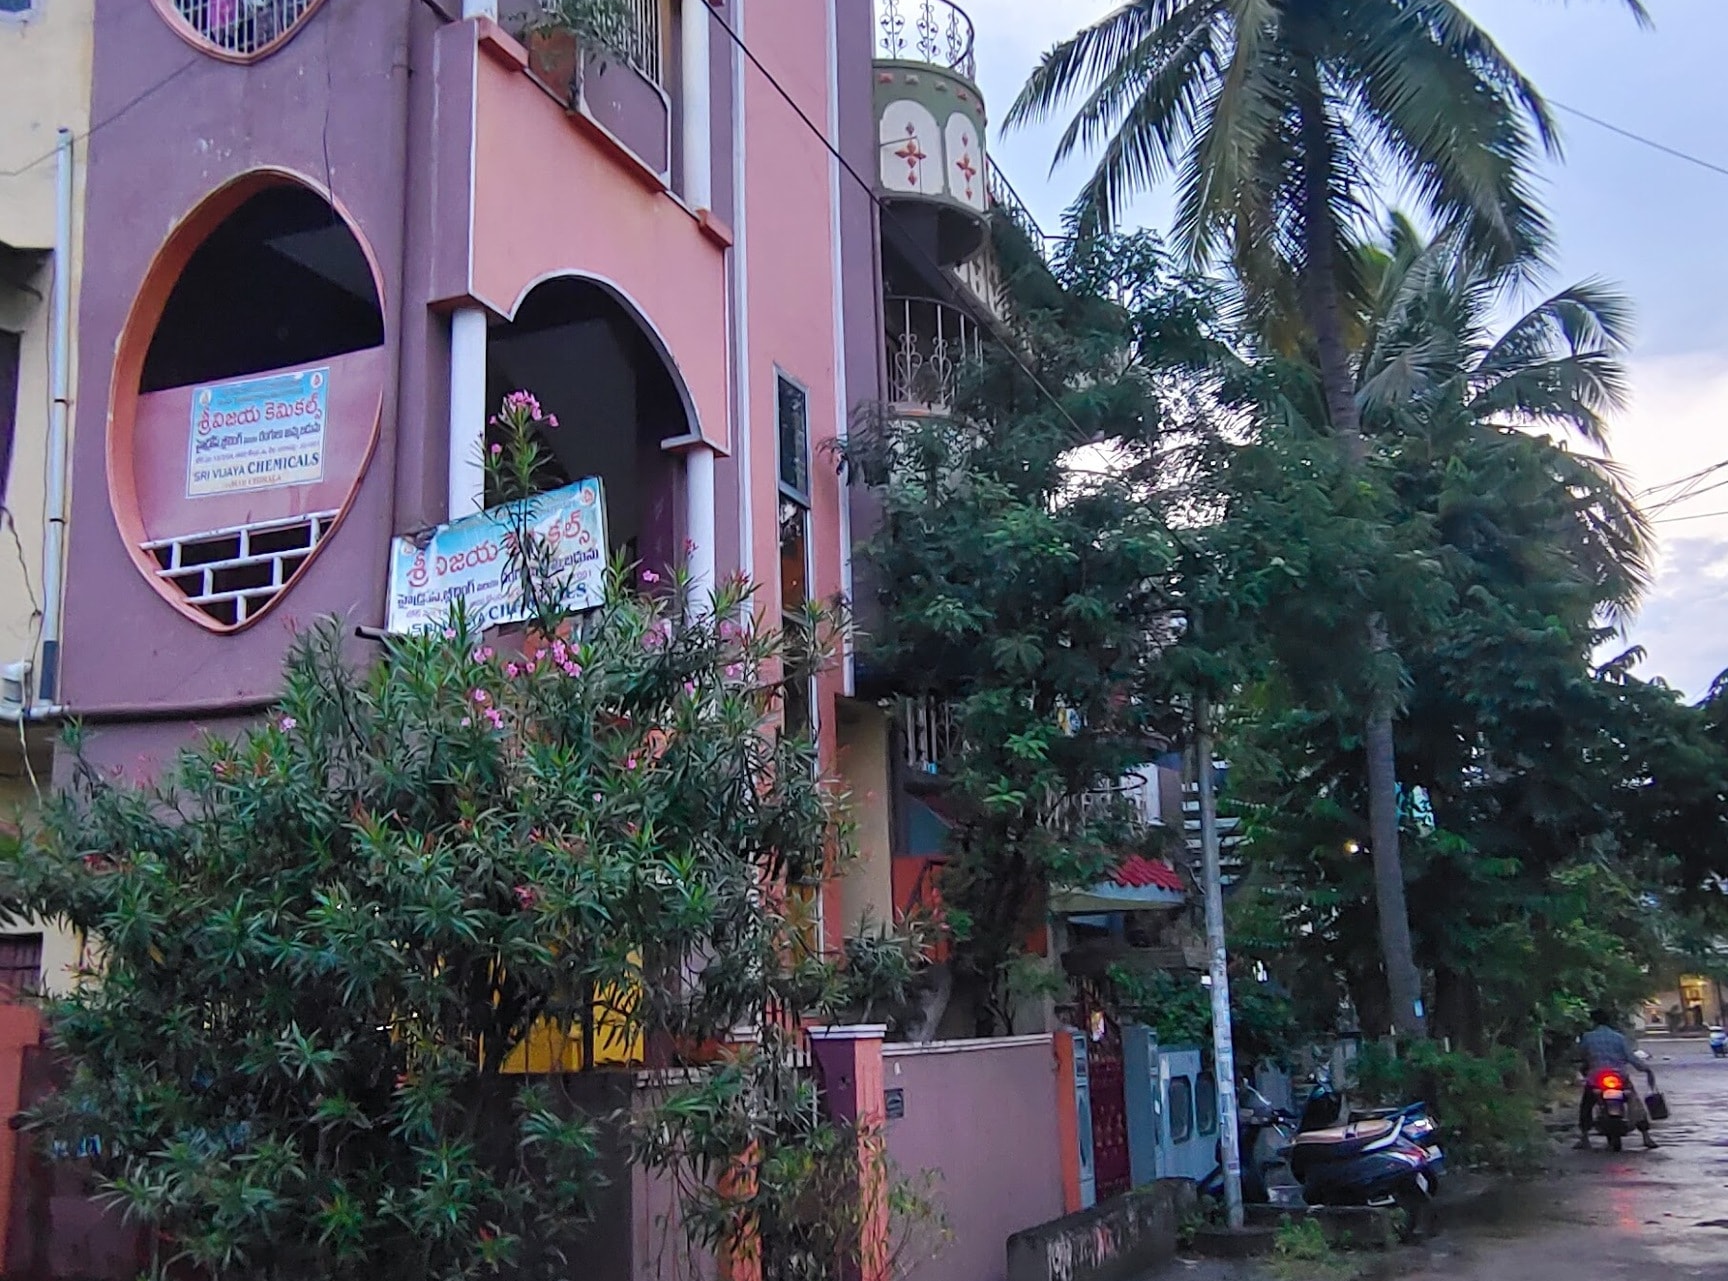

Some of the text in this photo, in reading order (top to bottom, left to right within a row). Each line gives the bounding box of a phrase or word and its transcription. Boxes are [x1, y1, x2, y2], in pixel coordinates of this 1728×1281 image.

[193, 470, 211, 483] SRI
[213, 466, 245, 480] VIJAYA
[247, 452, 320, 474] CHEMICALS
[406, 550, 429, 587] శ్రీ
[435, 540, 499, 576] విజయ
